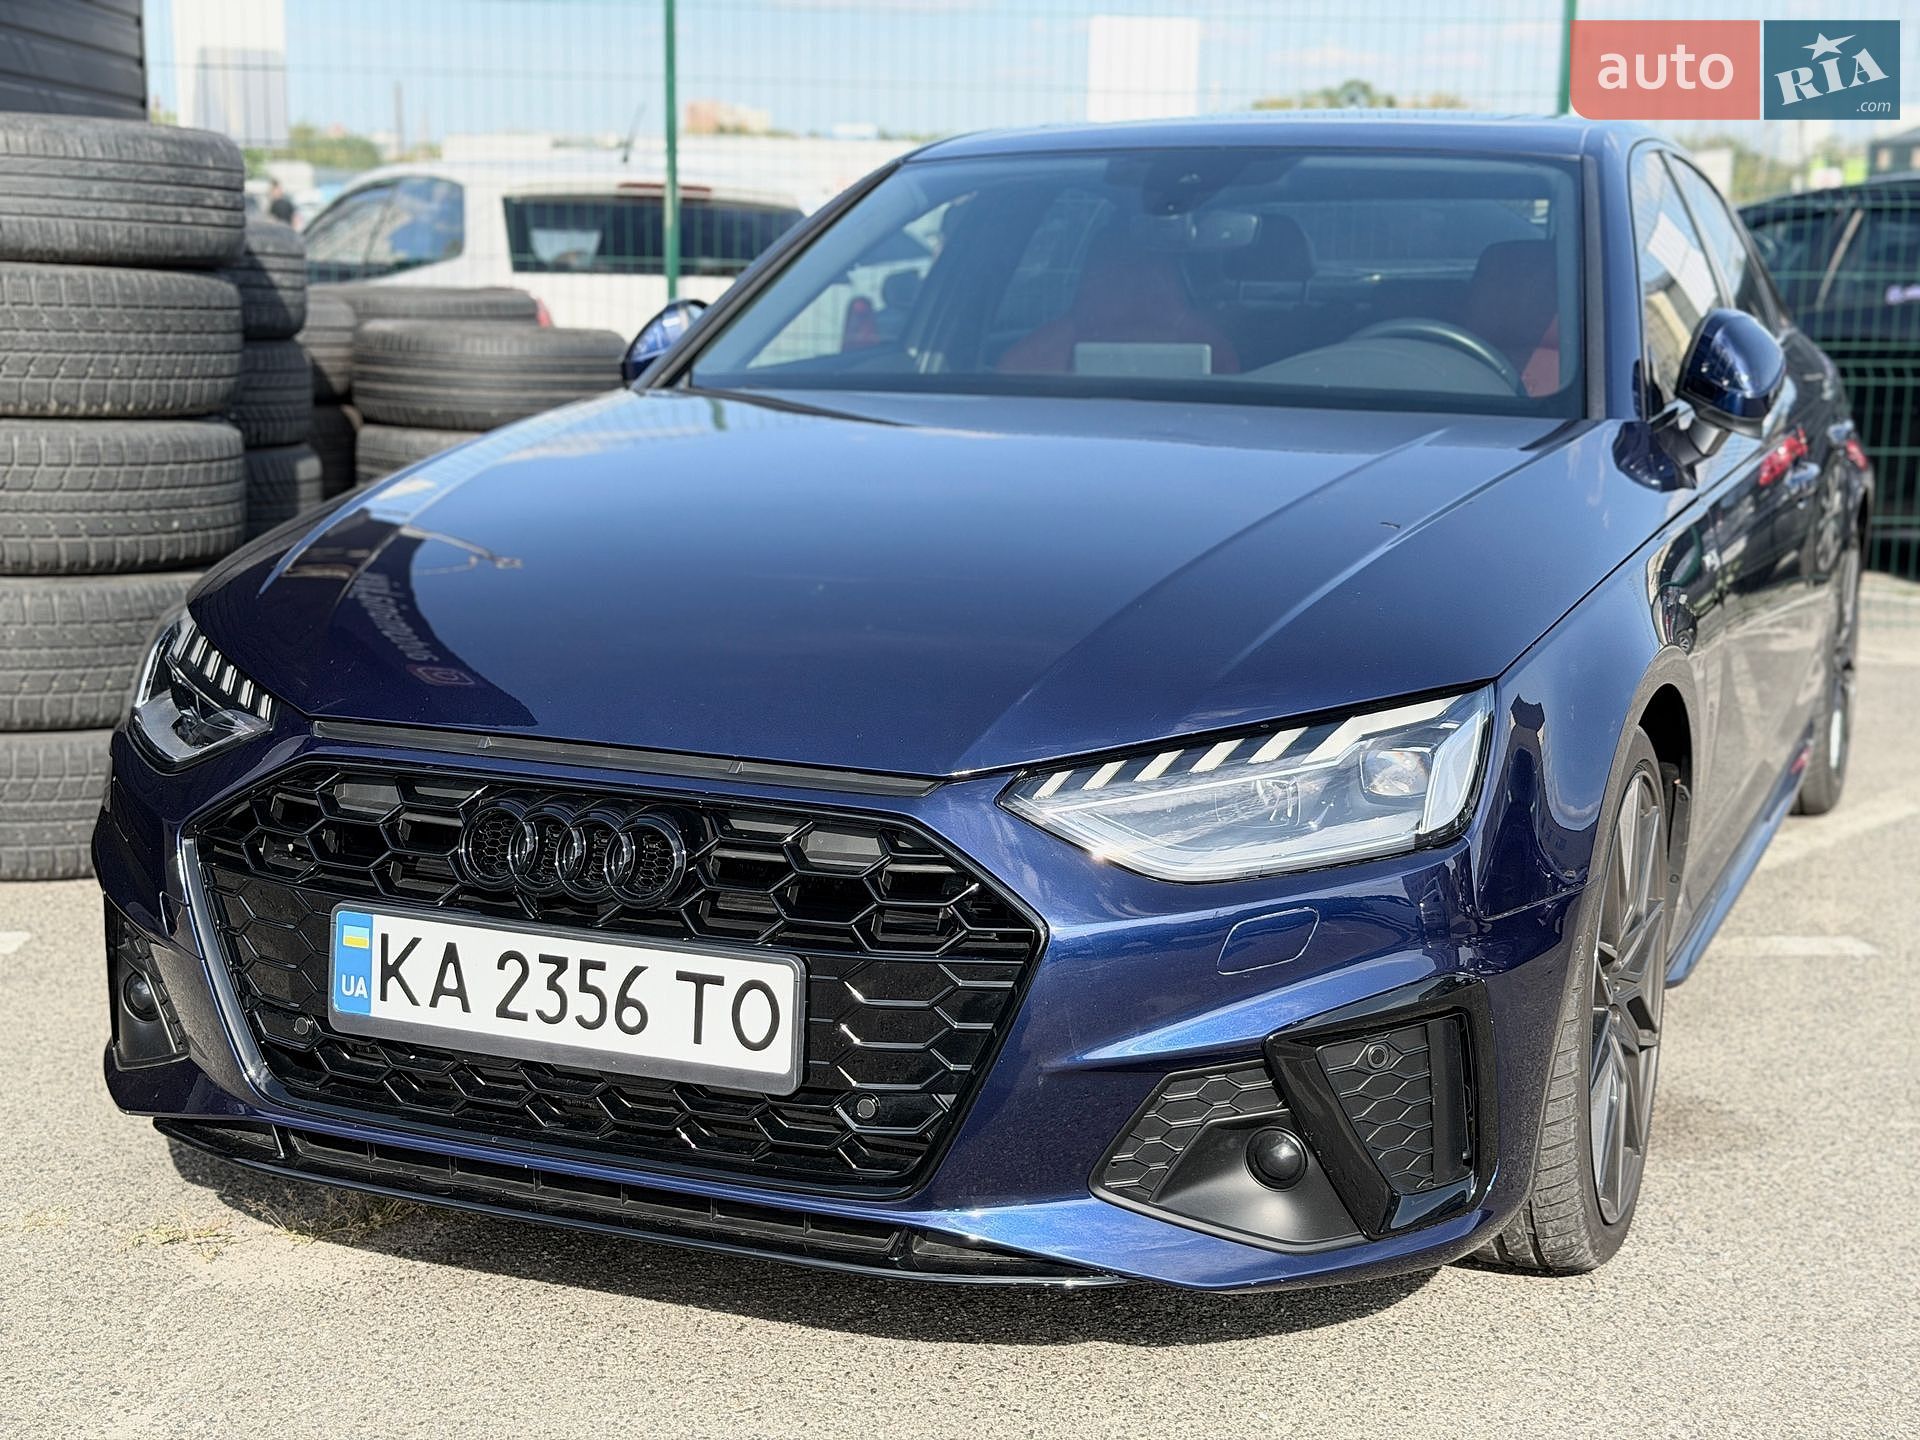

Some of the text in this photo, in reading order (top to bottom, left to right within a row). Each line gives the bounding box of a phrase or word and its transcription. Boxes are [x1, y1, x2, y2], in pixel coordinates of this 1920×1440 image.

[341, 974, 368, 999] UA
[379, 932, 781, 1052] KA 2356 TO
